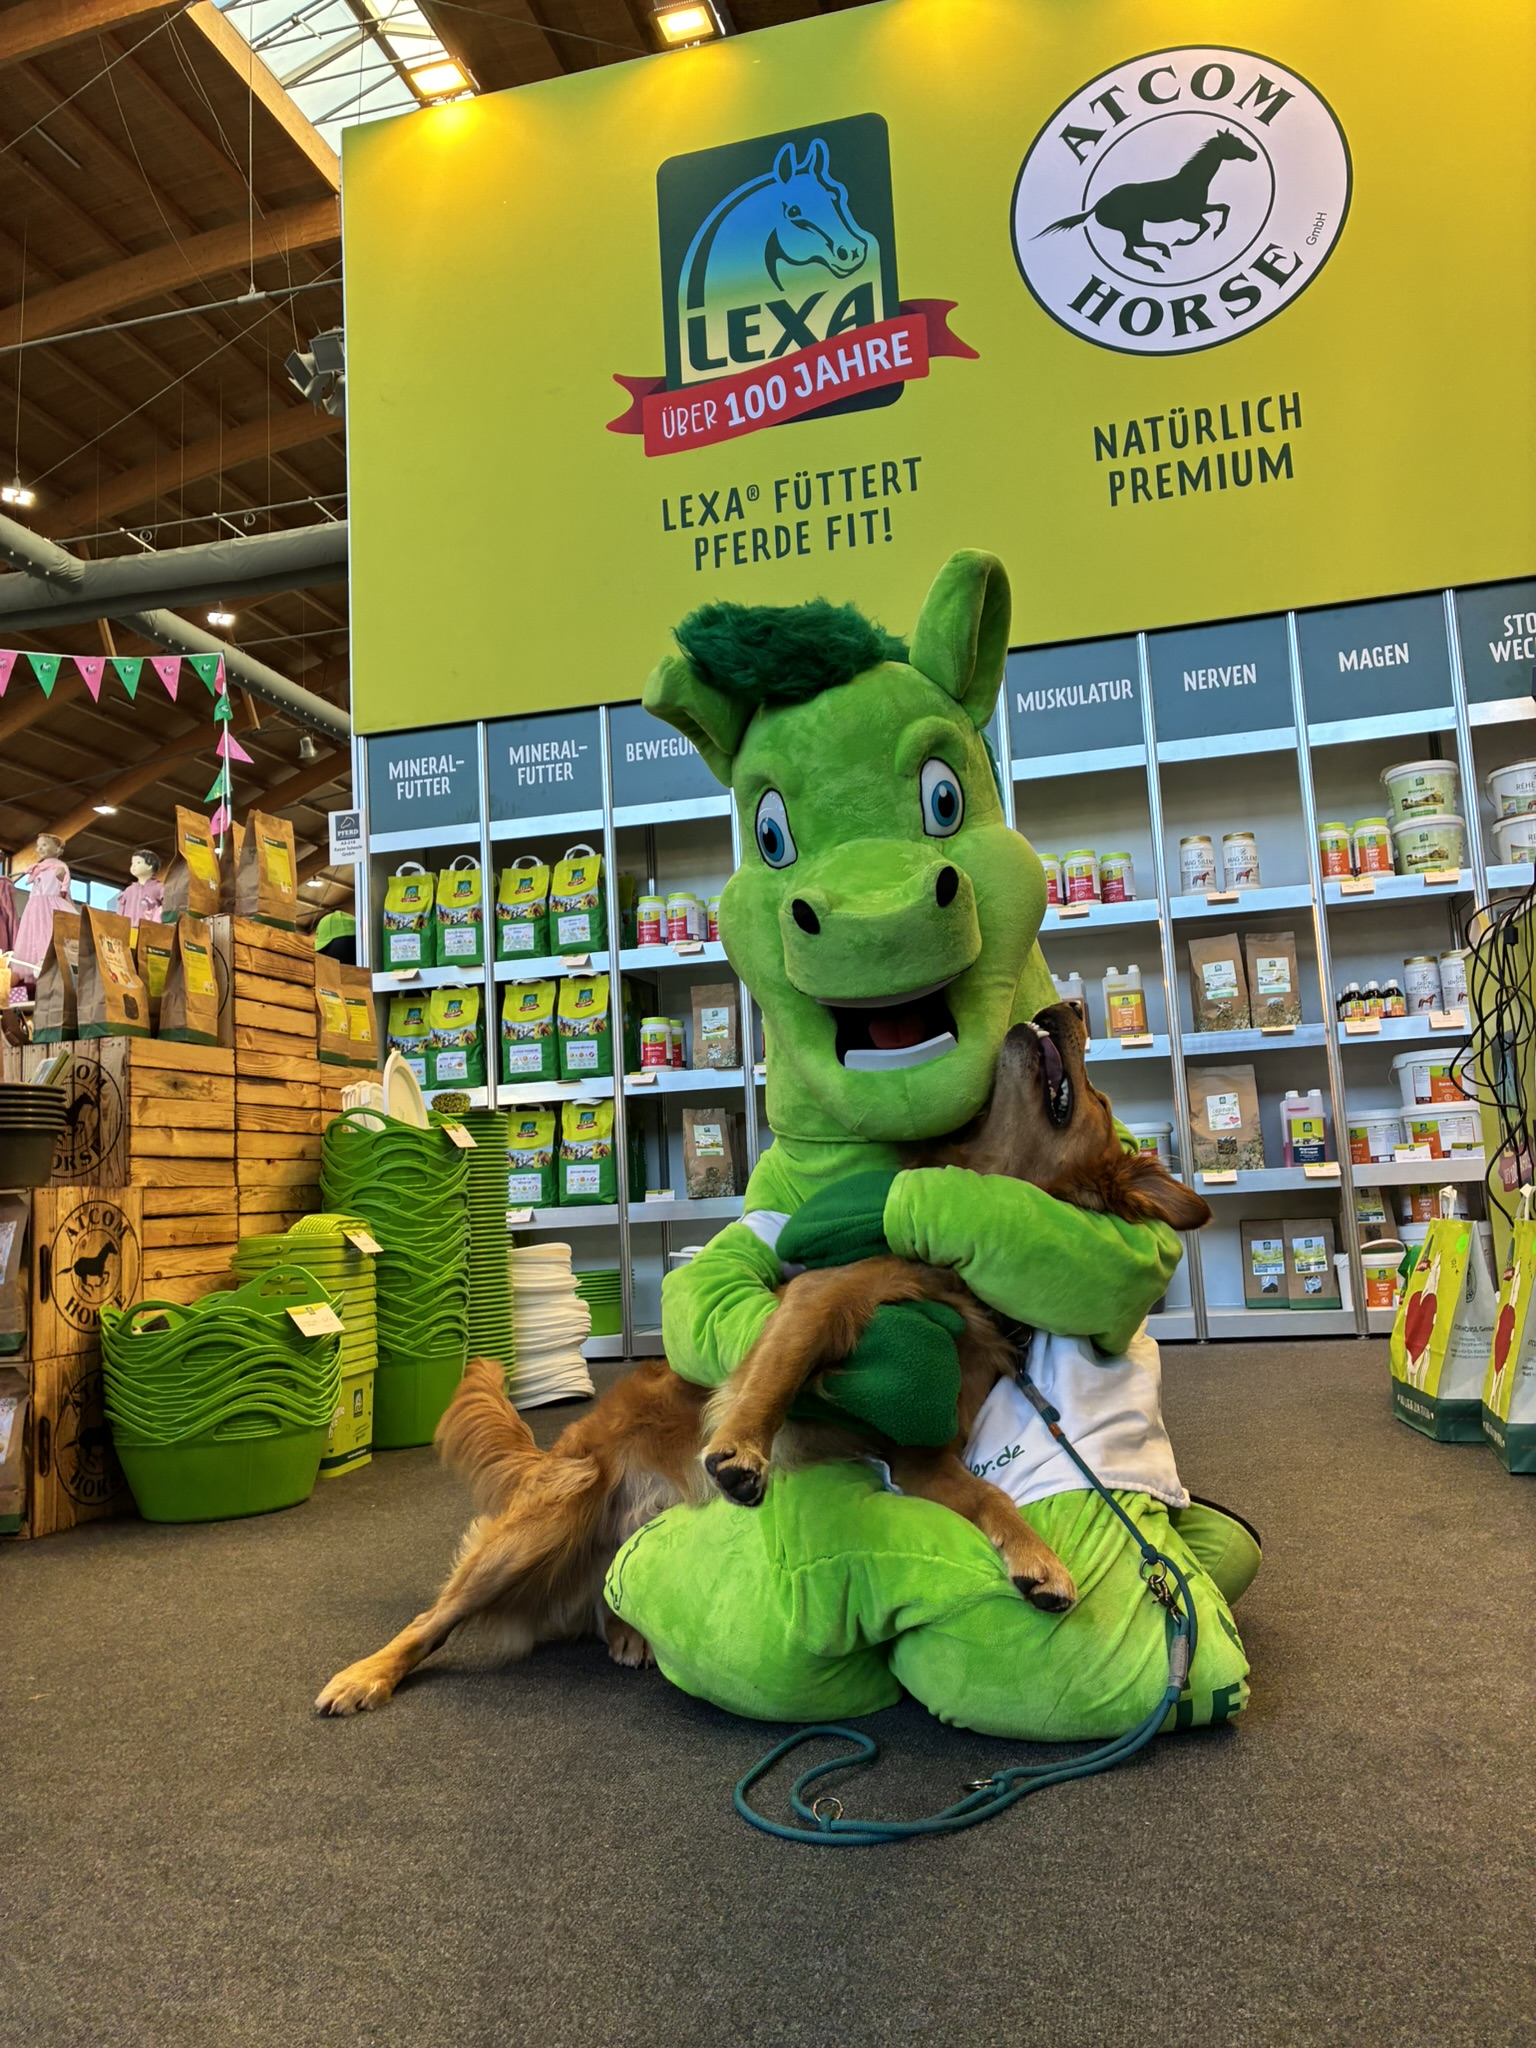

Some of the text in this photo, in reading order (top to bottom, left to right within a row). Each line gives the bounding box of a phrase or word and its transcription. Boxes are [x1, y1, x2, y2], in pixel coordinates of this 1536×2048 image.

[1059, 63, 1296, 165] ATCOM
[1305, 211, 1328, 246] GmbH
[1066, 242, 1304, 338] HORSE
[686, 281, 876, 372] LEXA
[661, 330, 914, 439] ÜBER 100 JAHRE
[1093, 391, 1303, 462] NATÜRLICH
[774, 455, 923, 514] FÜTTERT
[1108, 442, 1295, 508] PREMIUM
[693, 505, 894, 572] PFERDE FIT!
[1338, 642, 1410, 673] MAGEN
[1183, 663, 1257, 692] NERVEN
[1016, 679, 1134, 713] MUSKULATUR
[388, 754, 465, 781] MINERAL-
[509, 739, 588, 766] MINERAL-
[396, 776, 452, 801] FUTTER
[517, 762, 574, 787] FUTTER
[337, 829, 359, 837] PFERD
[65, 1208, 130, 1245] ATCOM
